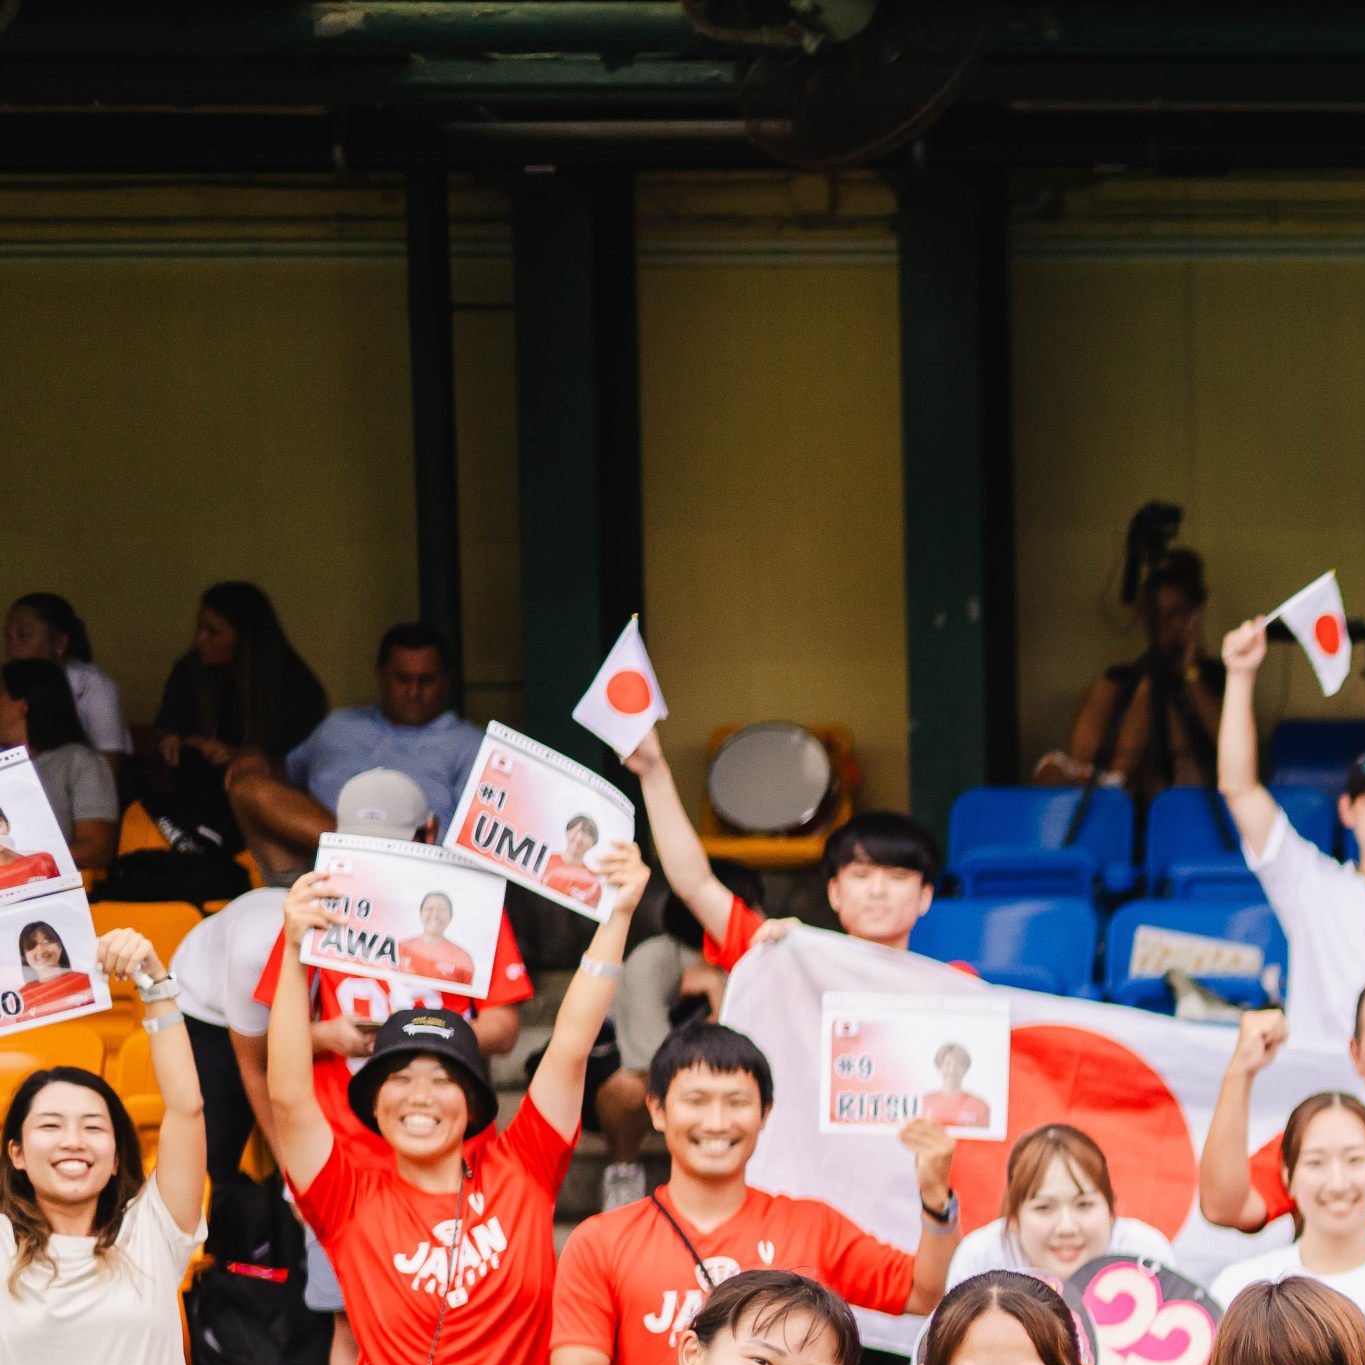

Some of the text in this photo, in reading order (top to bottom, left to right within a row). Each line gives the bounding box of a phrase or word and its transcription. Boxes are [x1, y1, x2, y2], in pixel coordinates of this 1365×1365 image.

[480, 784, 507, 811] #1
[474, 814, 549, 873] UMI
[320, 926, 398, 965] AWA
[838, 1054, 874, 1080] #9
[838, 1092, 919, 1121] RITSU
